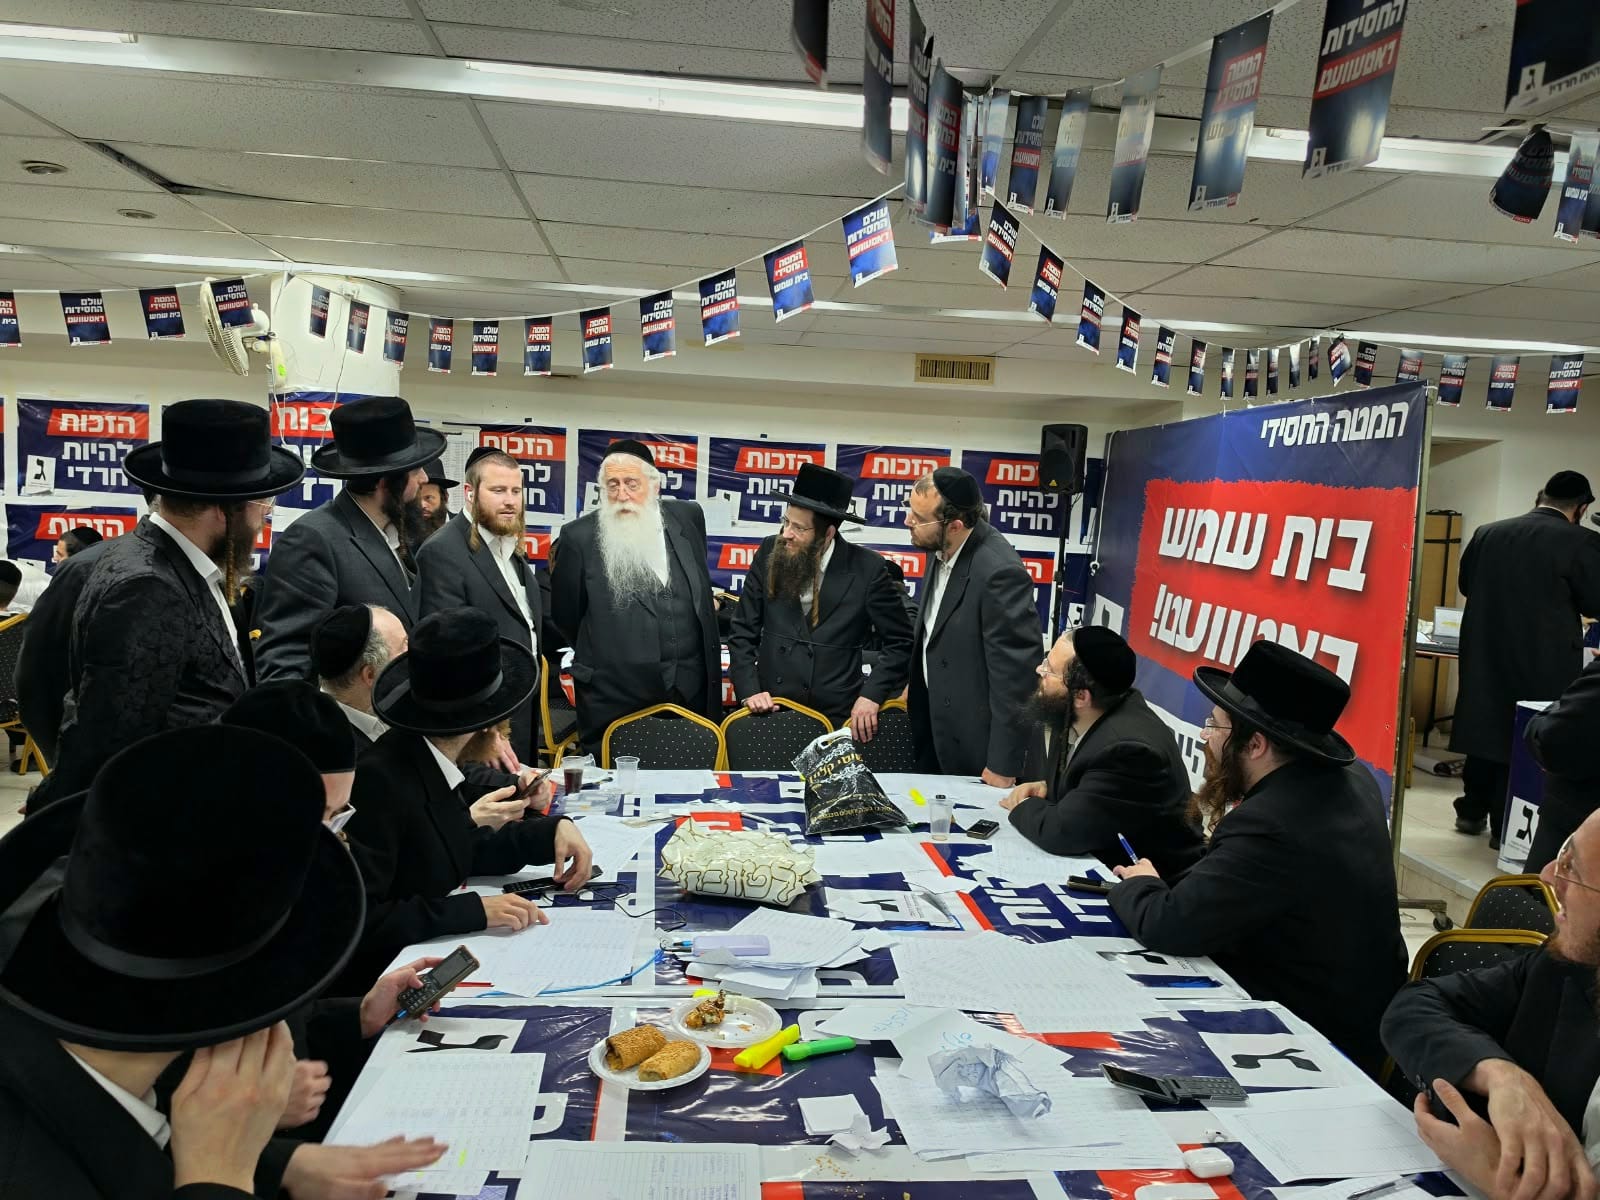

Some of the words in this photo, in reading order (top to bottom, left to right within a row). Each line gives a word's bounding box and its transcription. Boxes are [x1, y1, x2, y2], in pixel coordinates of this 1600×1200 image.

[1322, 2, 1405, 56] החסידות
[1226, 53, 1262, 84] המטה
[1318, 40, 1397, 92] ראטעוועט
[1218, 78, 1258, 104] החסידי
[1550, 77, 1576, 95] חרדי
[863, 206, 888, 226] עולם
[848, 220, 888, 245] החסידות
[990, 219, 1015, 249] החסידות
[1003, 220, 1018, 239] עולם
[775, 260, 803, 277] החסידי
[779, 251, 802, 268] המטה
[715, 278, 735, 292] עולם
[774, 278, 793, 293] שמש
[795, 272, 808, 284] בית
[216, 292, 247, 302] החסידות
[228, 285, 245, 293] עולם
[701, 289, 735, 307] החסידות
[65, 306, 103, 314] החסידות
[81, 298, 103, 306] עולם
[654, 300, 673, 311] עולם
[641, 309, 672, 323] החסידות
[586, 325, 608, 335] החסידי
[584, 339, 599, 348] שמש
[599, 336, 610, 344] בית
[1550, 369, 1580, 378] החסידות
[1563, 361, 1583, 369] עולם
[59, 413, 136, 434] הזכות
[277, 407, 332, 431] כות
[1331, 402, 1409, 442] המטה
[1260, 413, 1330, 448] החסידי
[62, 441, 133, 461] להיות
[746, 451, 814, 470] הזכות
[34, 459, 46, 481] ג
[68, 466, 129, 486] חרדי
[872, 457, 938, 476] הזכות
[996, 463, 1037, 482] כות
[747, 477, 794, 496] היות
[751, 500, 788, 517] רדי
[1000, 511, 1052, 531] חרדי
[1158, 508, 1268, 571] שמש
[1270, 515, 1373, 592] בית
[1516, 805, 1533, 844] ג
